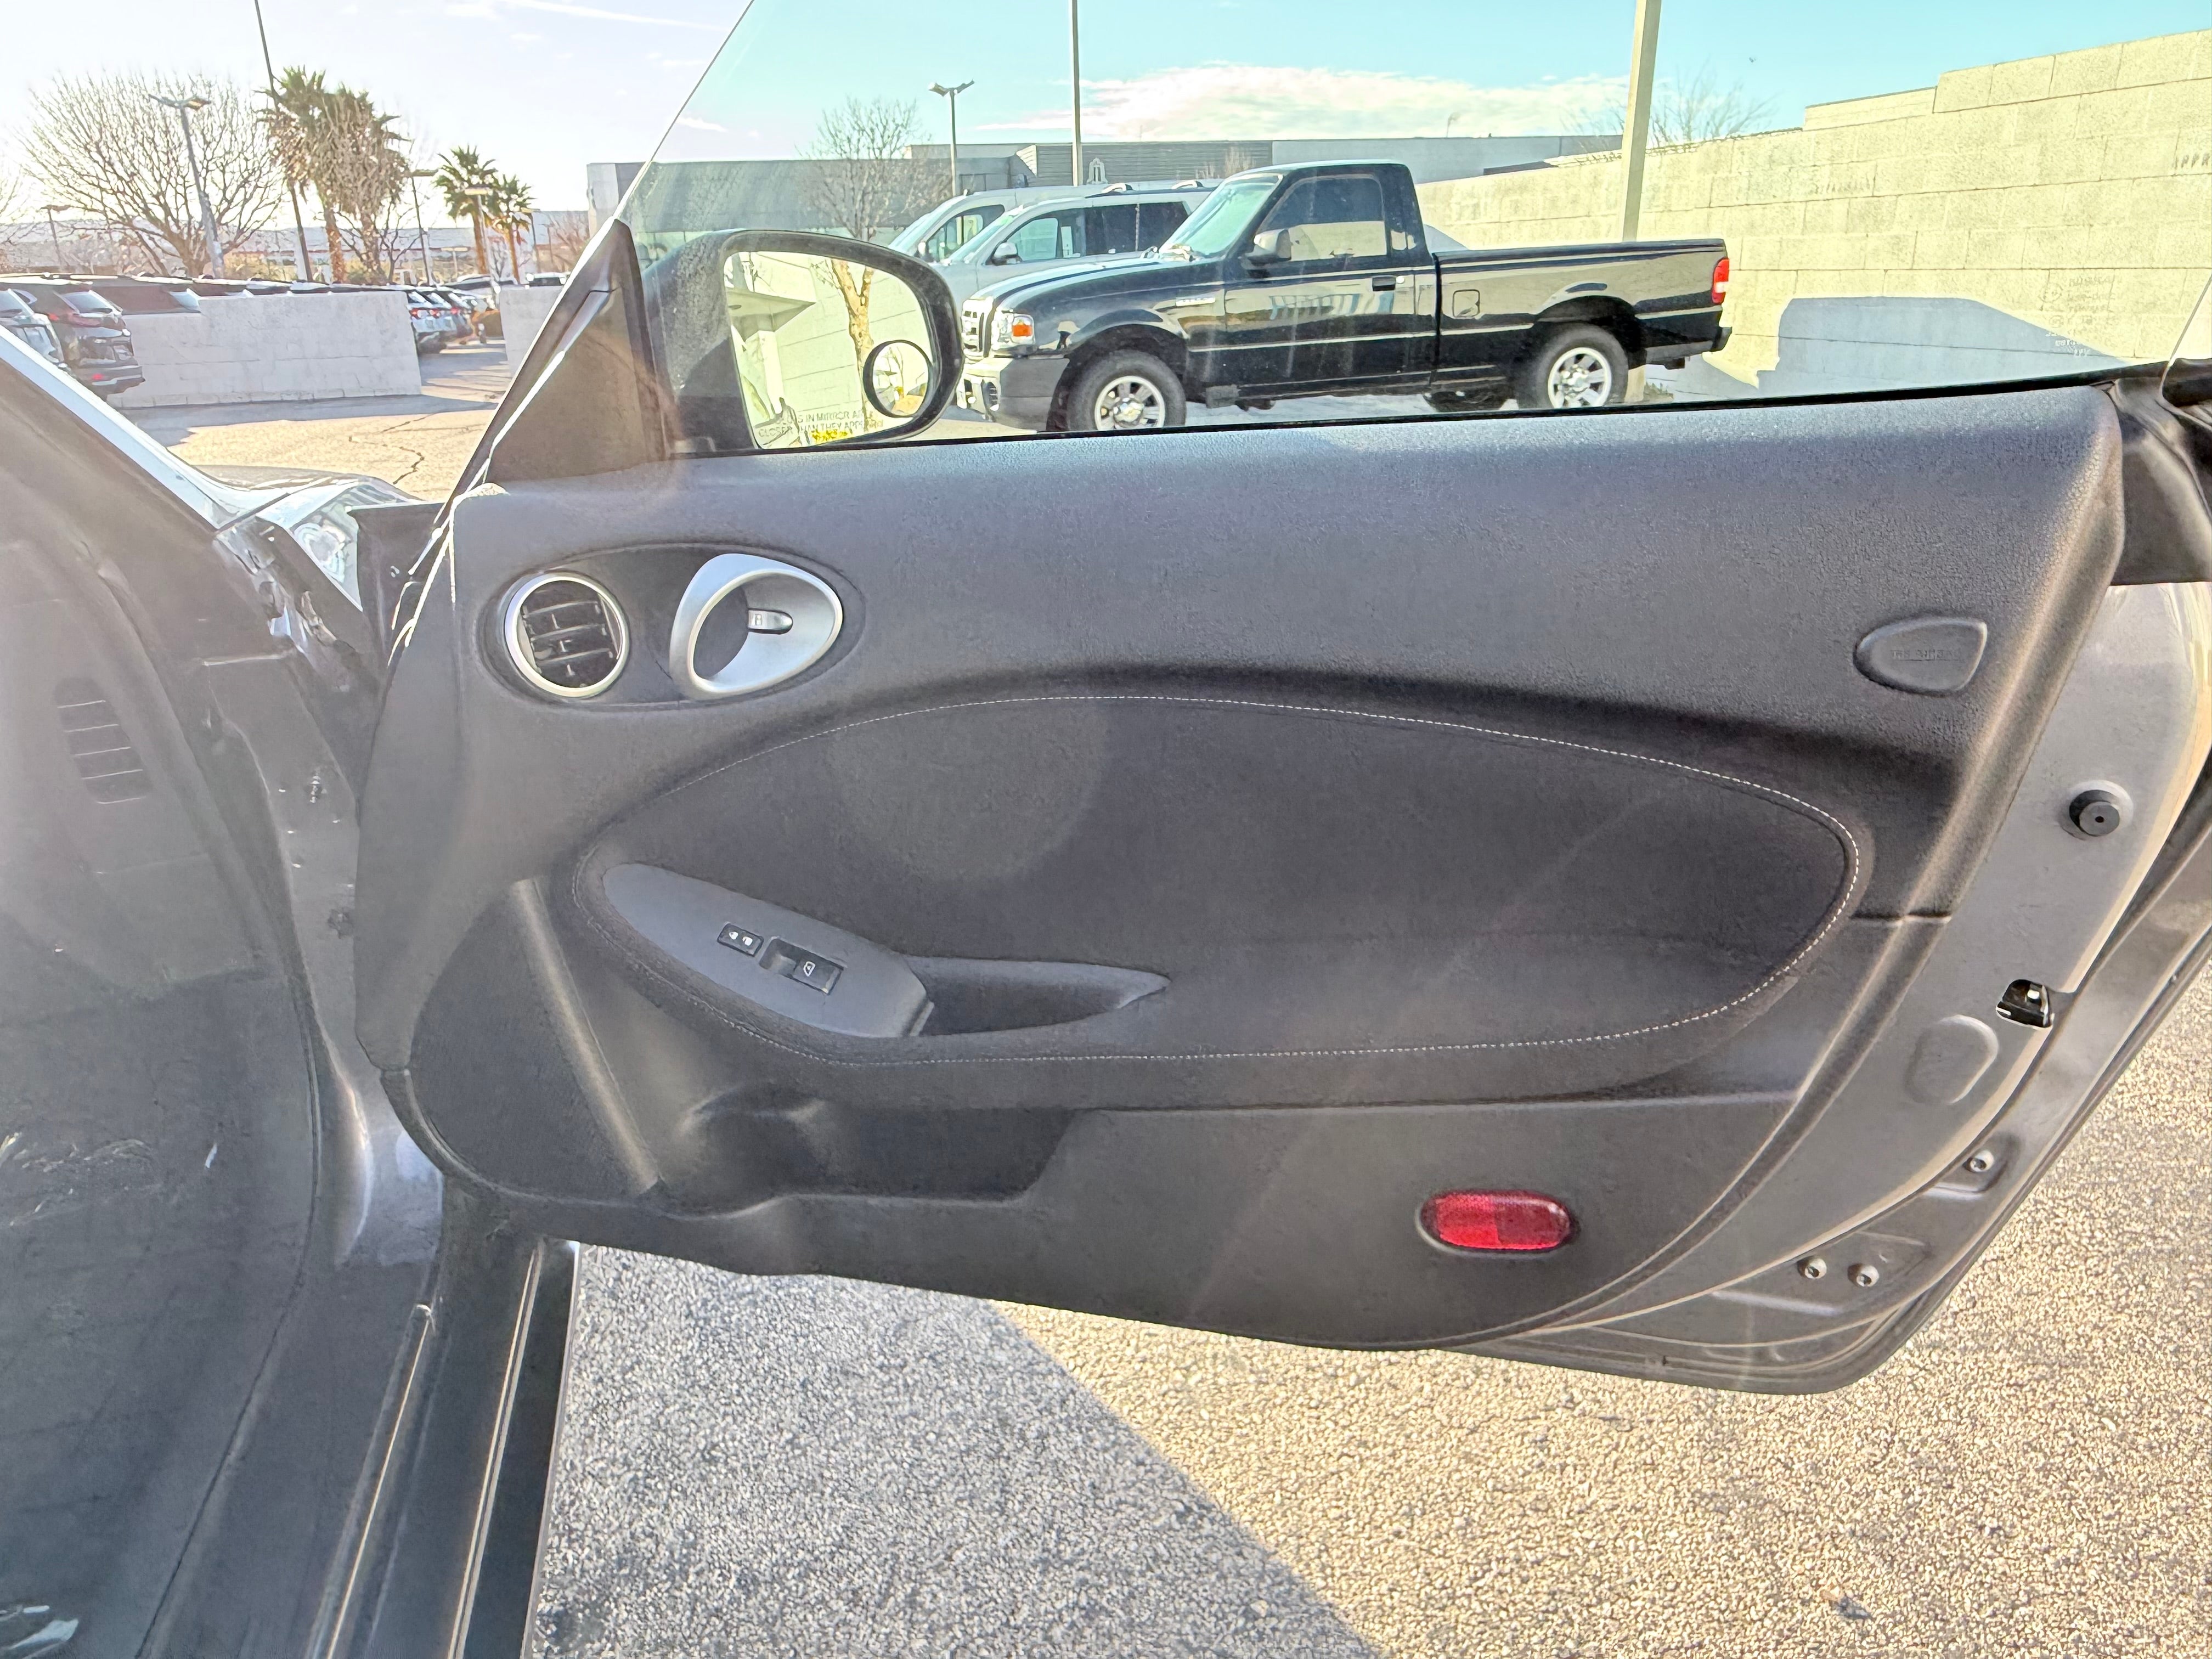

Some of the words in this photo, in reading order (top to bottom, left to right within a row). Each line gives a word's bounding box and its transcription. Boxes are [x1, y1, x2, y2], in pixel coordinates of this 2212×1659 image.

[816, 410, 850, 421] MIRROR
[758, 426, 794, 438] CLOSER
[820, 421, 842, 432] THEY
